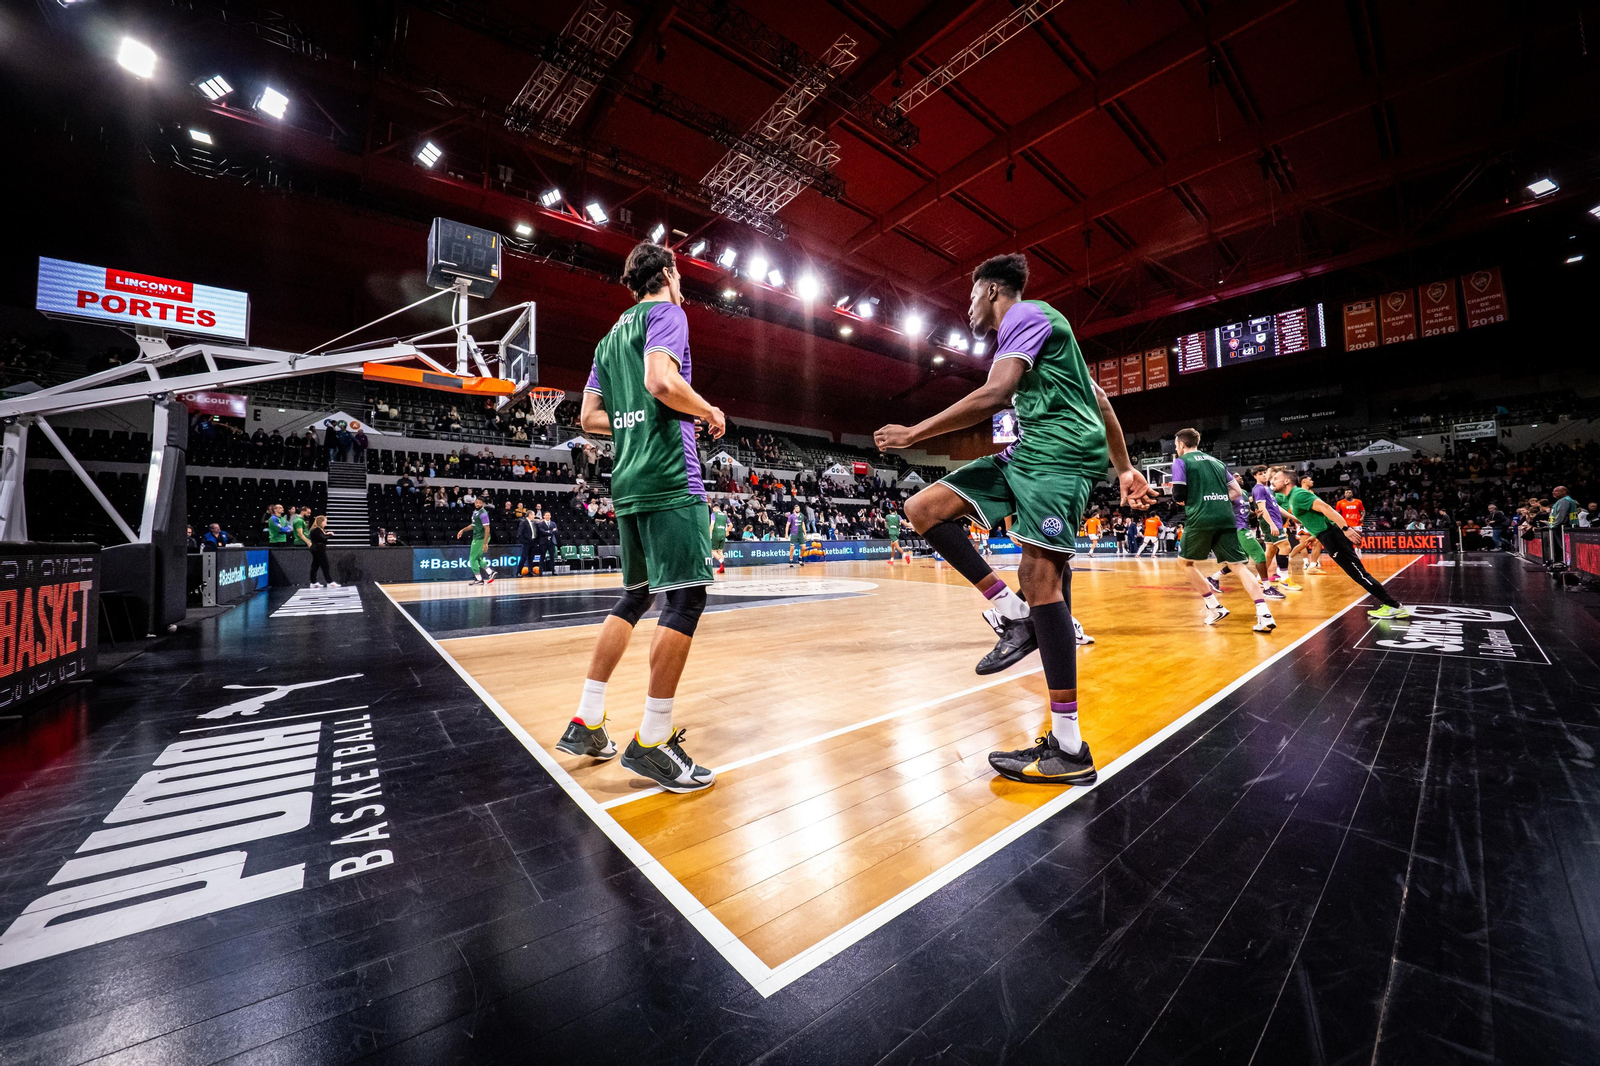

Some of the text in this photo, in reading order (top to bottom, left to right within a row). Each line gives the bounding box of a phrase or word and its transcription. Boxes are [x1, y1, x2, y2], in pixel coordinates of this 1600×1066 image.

[116, 276, 185, 294] LINCONYL
[1467, 294, 1502, 304] CHAMPION
[76, 290, 216, 327] PORTES
[1426, 305, 1450, 314] COUPE
[1471, 305, 1500, 314] FRANCE
[1384, 313, 1412, 322] LEADERS
[1426, 316, 1452, 324] FRANCE
[1472, 314, 1504, 327] 2018
[1348, 322, 1374, 330] SEMAINE
[1425, 326, 1456, 336] 2016
[1386, 334, 1414, 344] 2014
[1349, 340, 1376, 350] 2009
[1124, 386, 1141, 394] 2006
[1149, 381, 1166, 390] 2009
[254, 409, 261, 421] E
[1502, 429, 1512, 438] N
[1441, 435, 1450, 444] N
[1354, 535, 1444, 549] ARTHE BASKET
[0, 580, 92, 678] BASKET
[1376, 620, 1464, 652] Sarthe
[329, 714, 394, 880] BASKETBALL
[0, 722, 322, 970] PUMA
